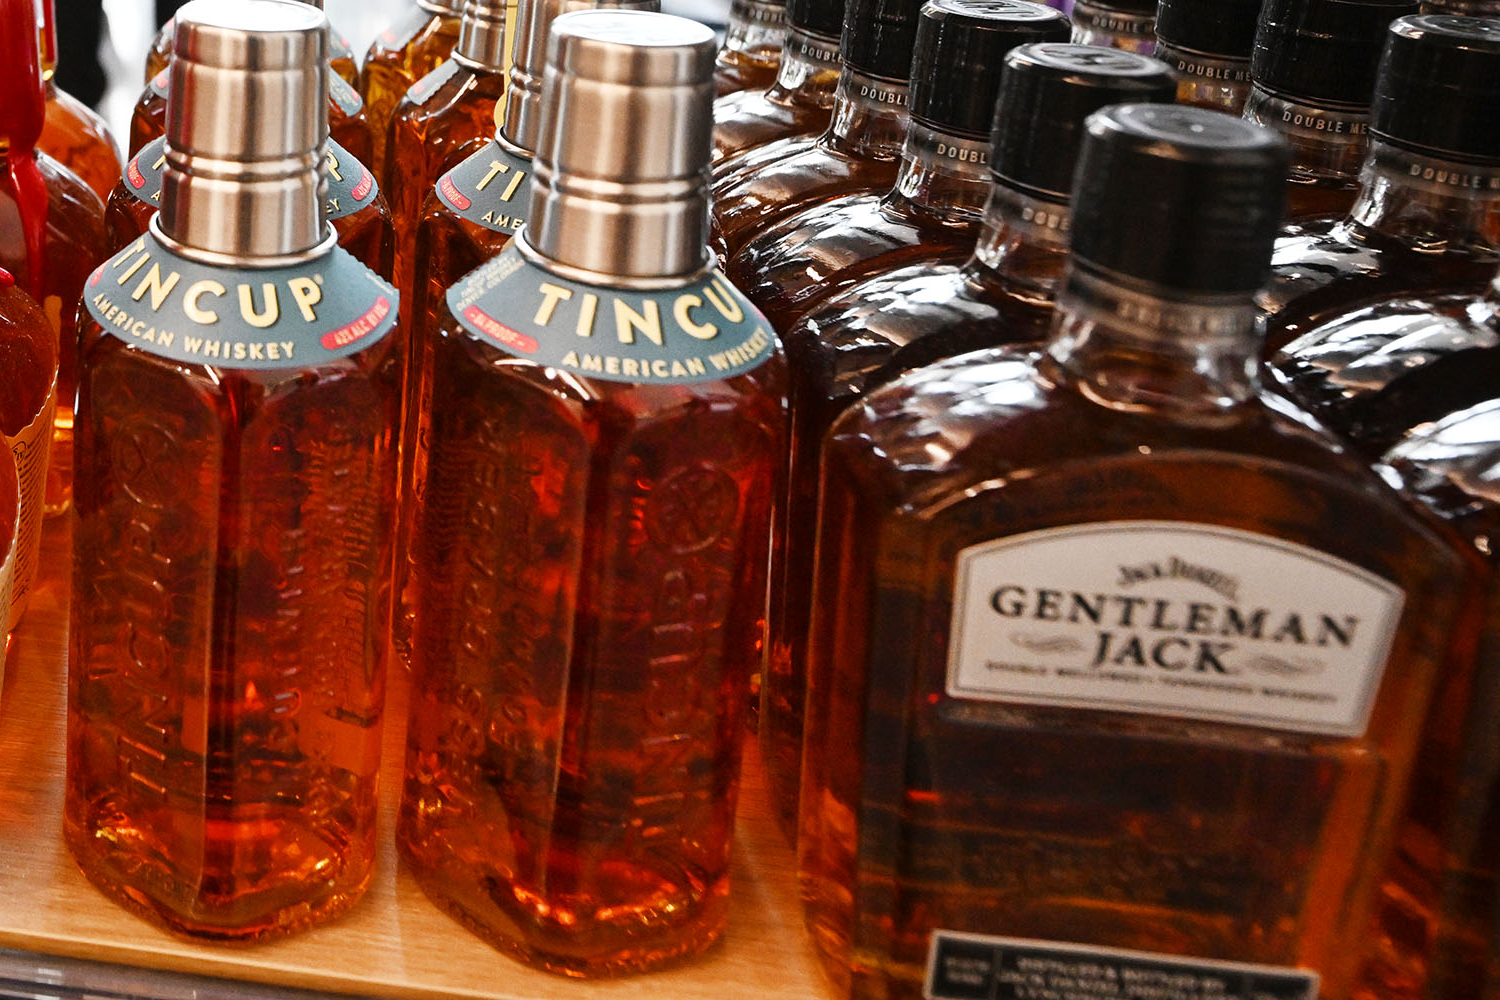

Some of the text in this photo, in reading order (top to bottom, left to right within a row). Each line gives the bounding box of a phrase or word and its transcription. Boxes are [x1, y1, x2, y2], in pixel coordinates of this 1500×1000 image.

[1178, 60, 1232, 81] DOUBLE
[1282, 109, 1343, 134] DOUBLE
[937, 143, 988, 166] DOUBL
[1408, 163, 1482, 190] DOUBLE
[112, 237, 322, 329] TINCUP
[533, 268, 746, 346] TINCU
[92, 292, 295, 361] AMERICAN WHISKEY
[561, 327, 770, 379] AMERICAN WHISKEY
[989, 585, 1361, 650] GENTLEMAN
[1092, 631, 1240, 676] JACK
